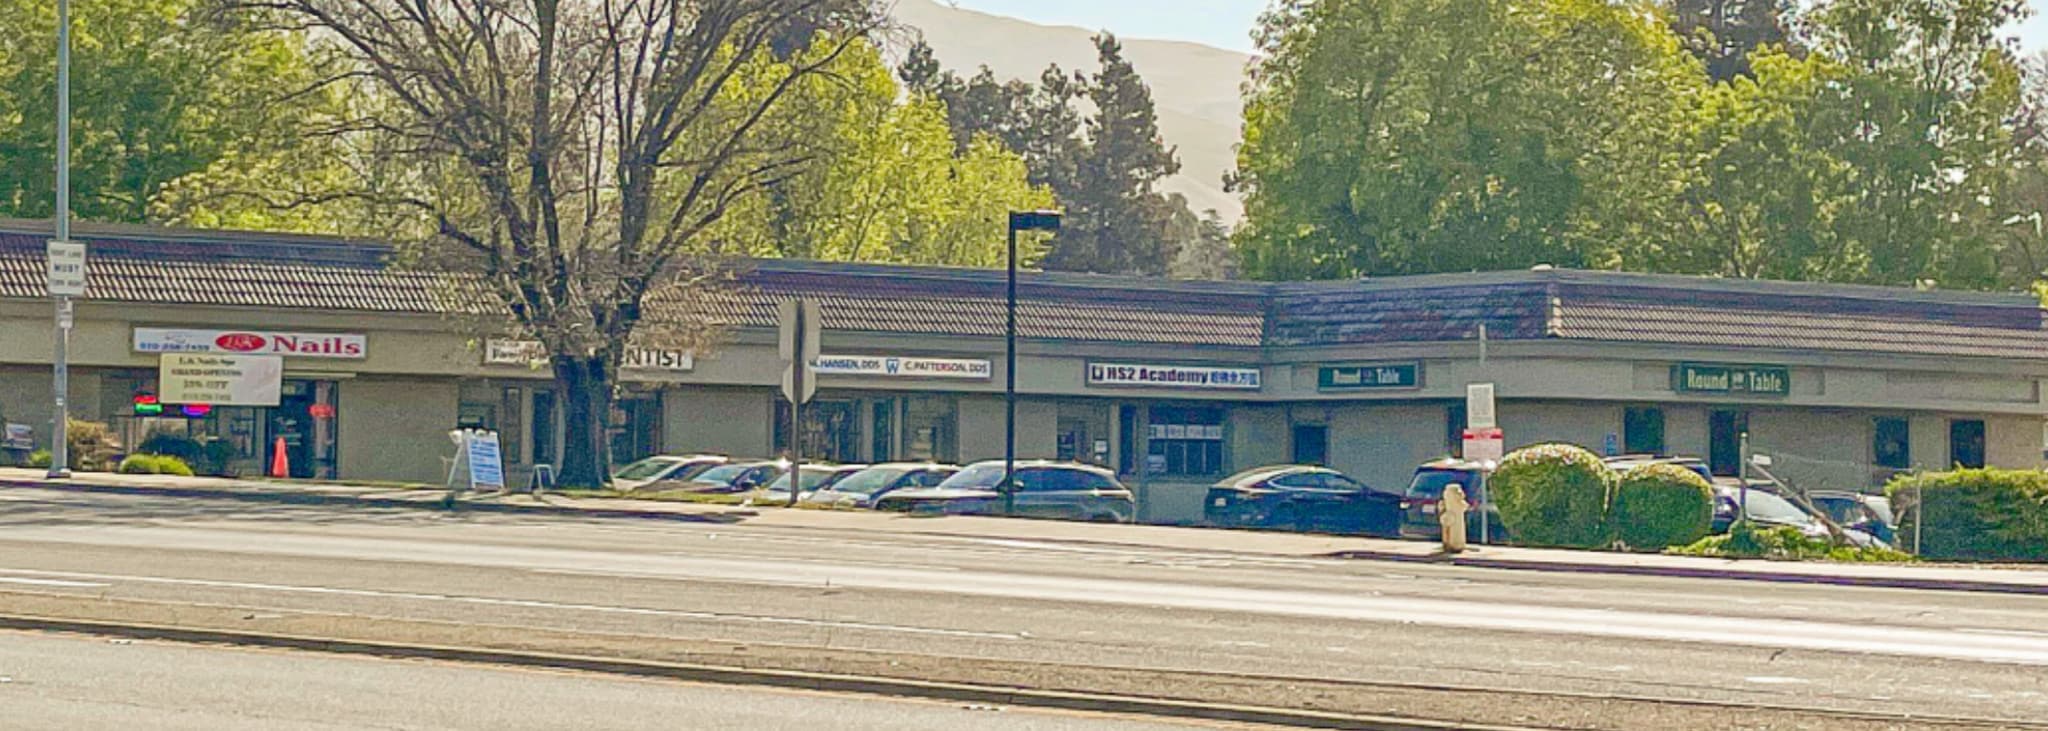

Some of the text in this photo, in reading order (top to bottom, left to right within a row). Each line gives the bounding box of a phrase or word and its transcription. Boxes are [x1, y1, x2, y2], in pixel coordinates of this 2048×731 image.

[271, 335, 361, 354] Nails
[1107, 366, 1208, 384] HS2 Academy
[1687, 368, 1783, 392] Round Table
